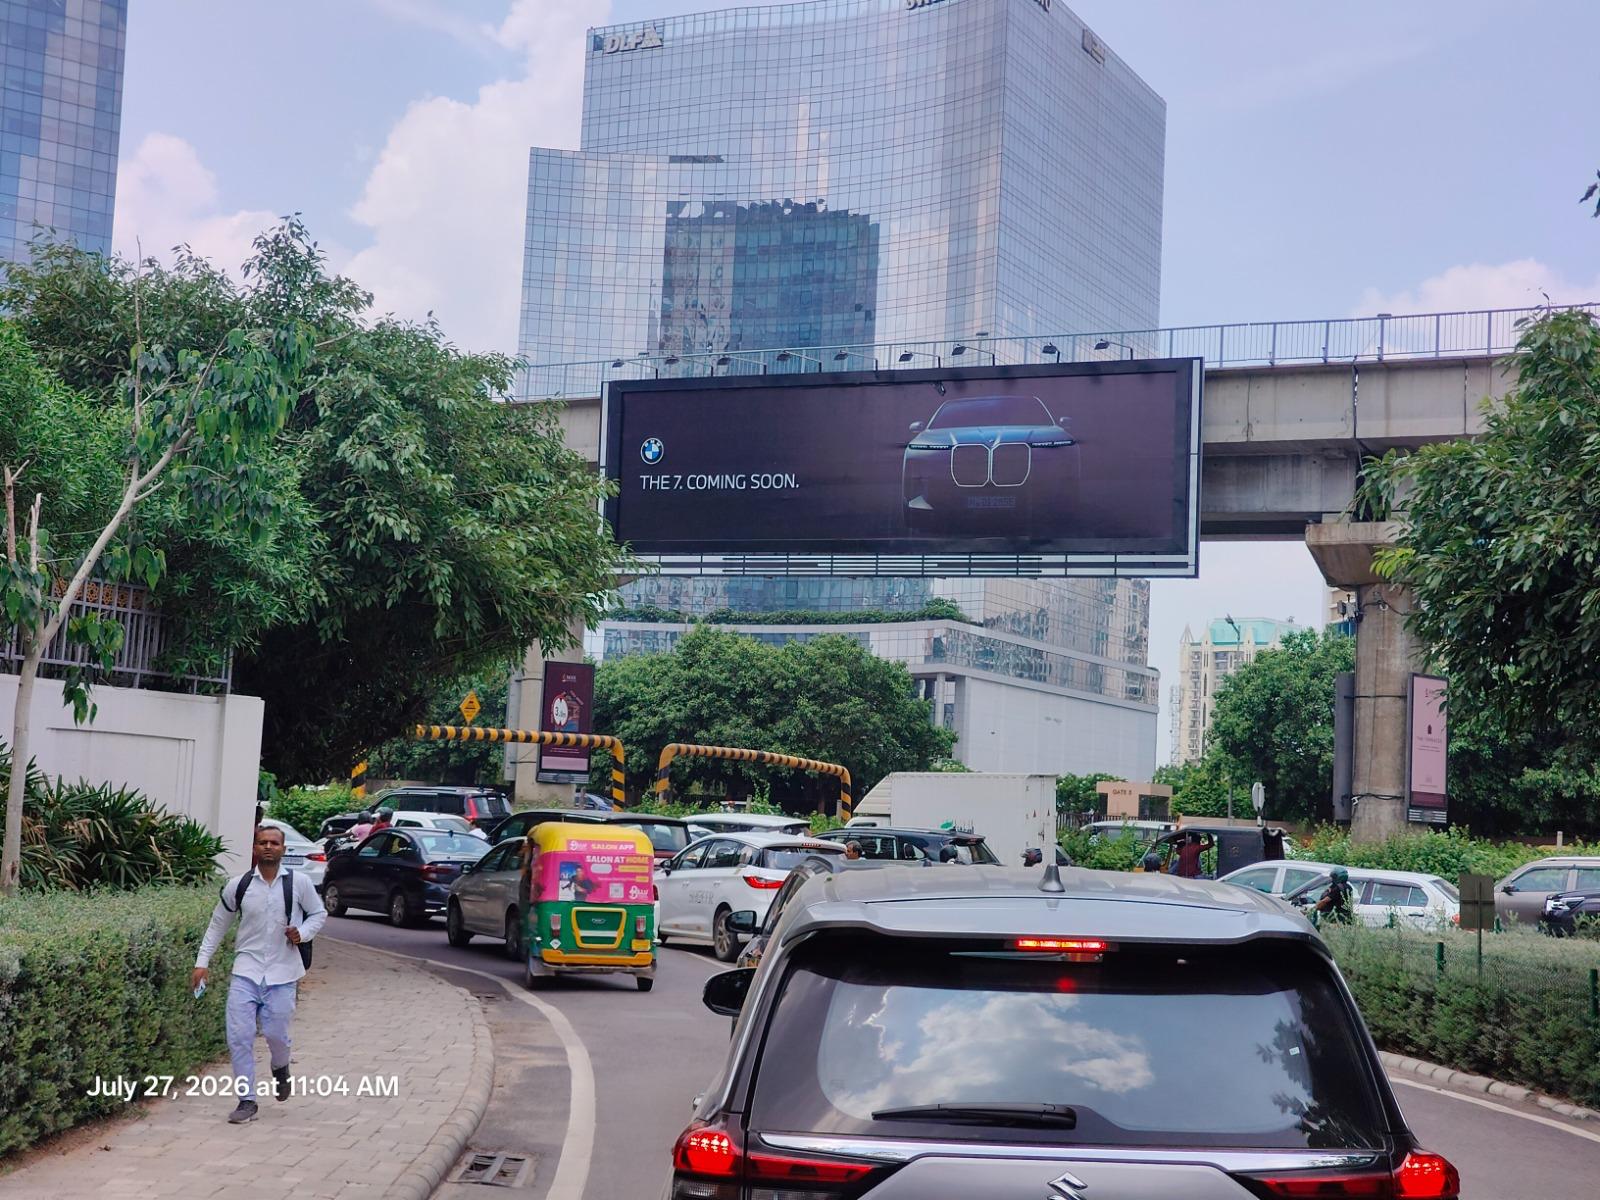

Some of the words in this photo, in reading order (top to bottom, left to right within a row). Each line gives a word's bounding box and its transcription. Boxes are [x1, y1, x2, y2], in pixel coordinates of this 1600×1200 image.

[604, 33, 644, 54] DLF
[640, 475, 670, 490] THE
[673, 475, 683, 490] 7.
[686, 474, 746, 490] COMING
[750, 473, 800, 489] SOON.
[591, 842, 618, 850] SALON
[614, 856, 625, 864] AT
[626, 856, 650, 864] HOME
